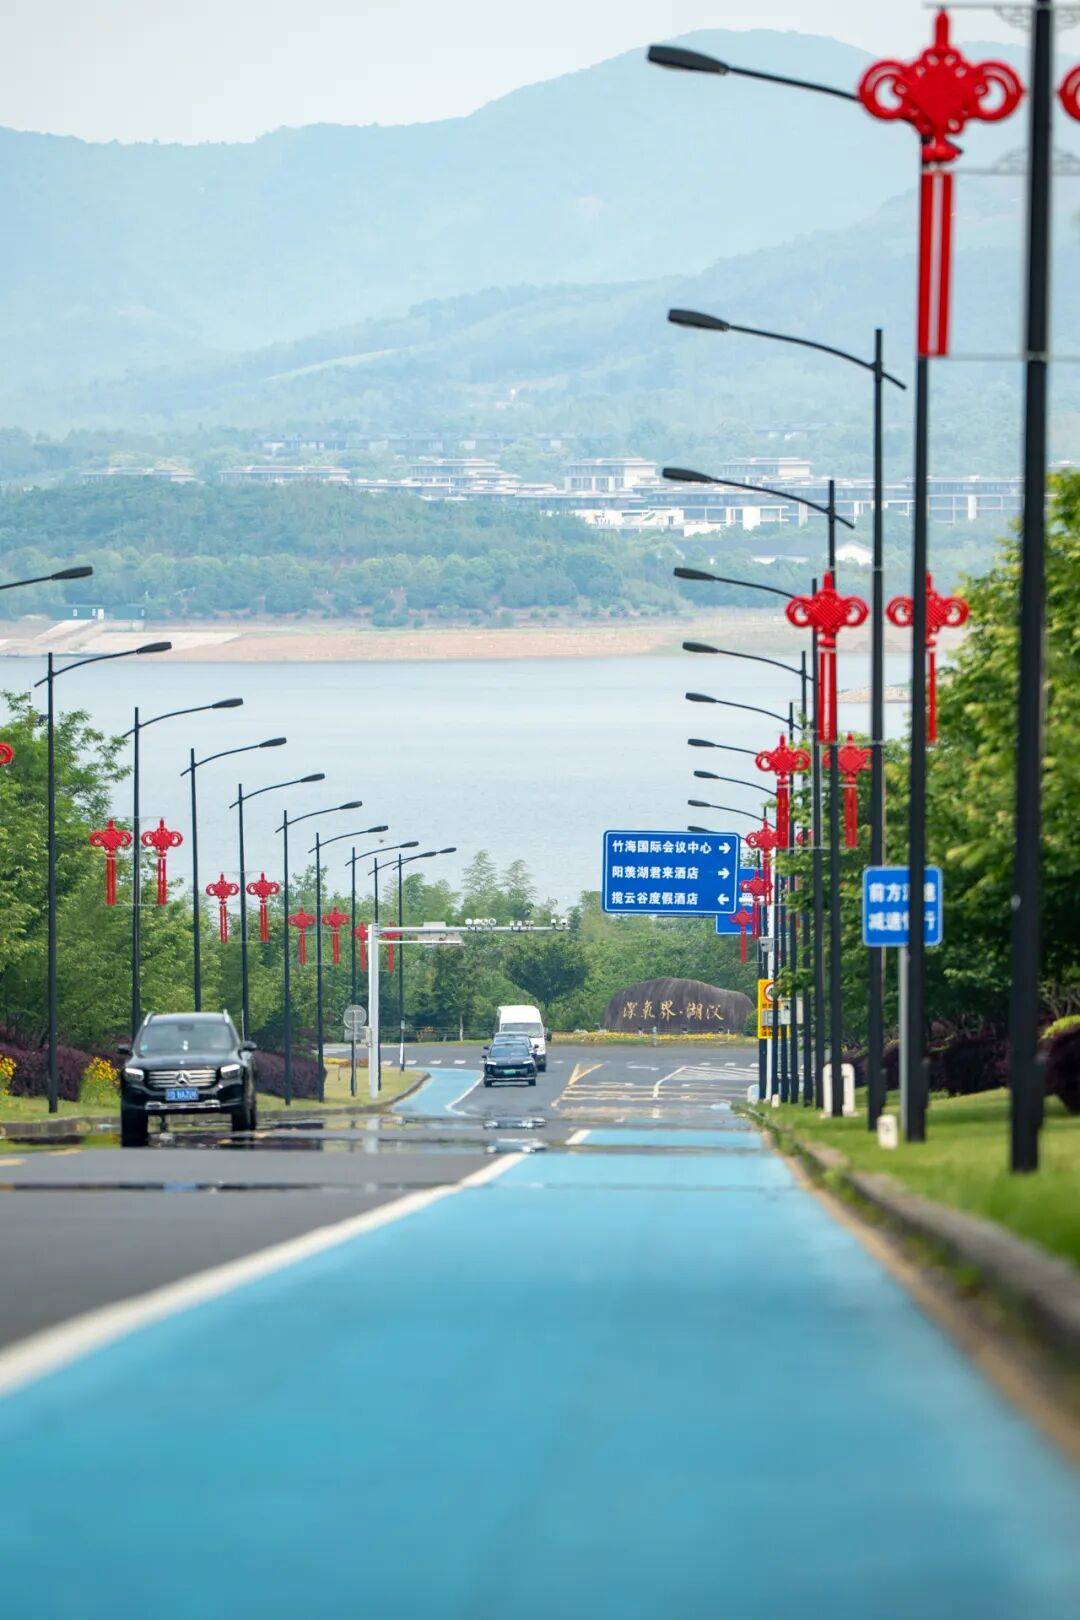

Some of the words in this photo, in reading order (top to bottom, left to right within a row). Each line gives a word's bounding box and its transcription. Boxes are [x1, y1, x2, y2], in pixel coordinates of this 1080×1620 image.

[612, 840, 712, 854] 竹海国际会议中心
[611, 866, 699, 880] 阳羡湖君来酒店
[611, 891, 699, 905] 揽云谷度假酒店
